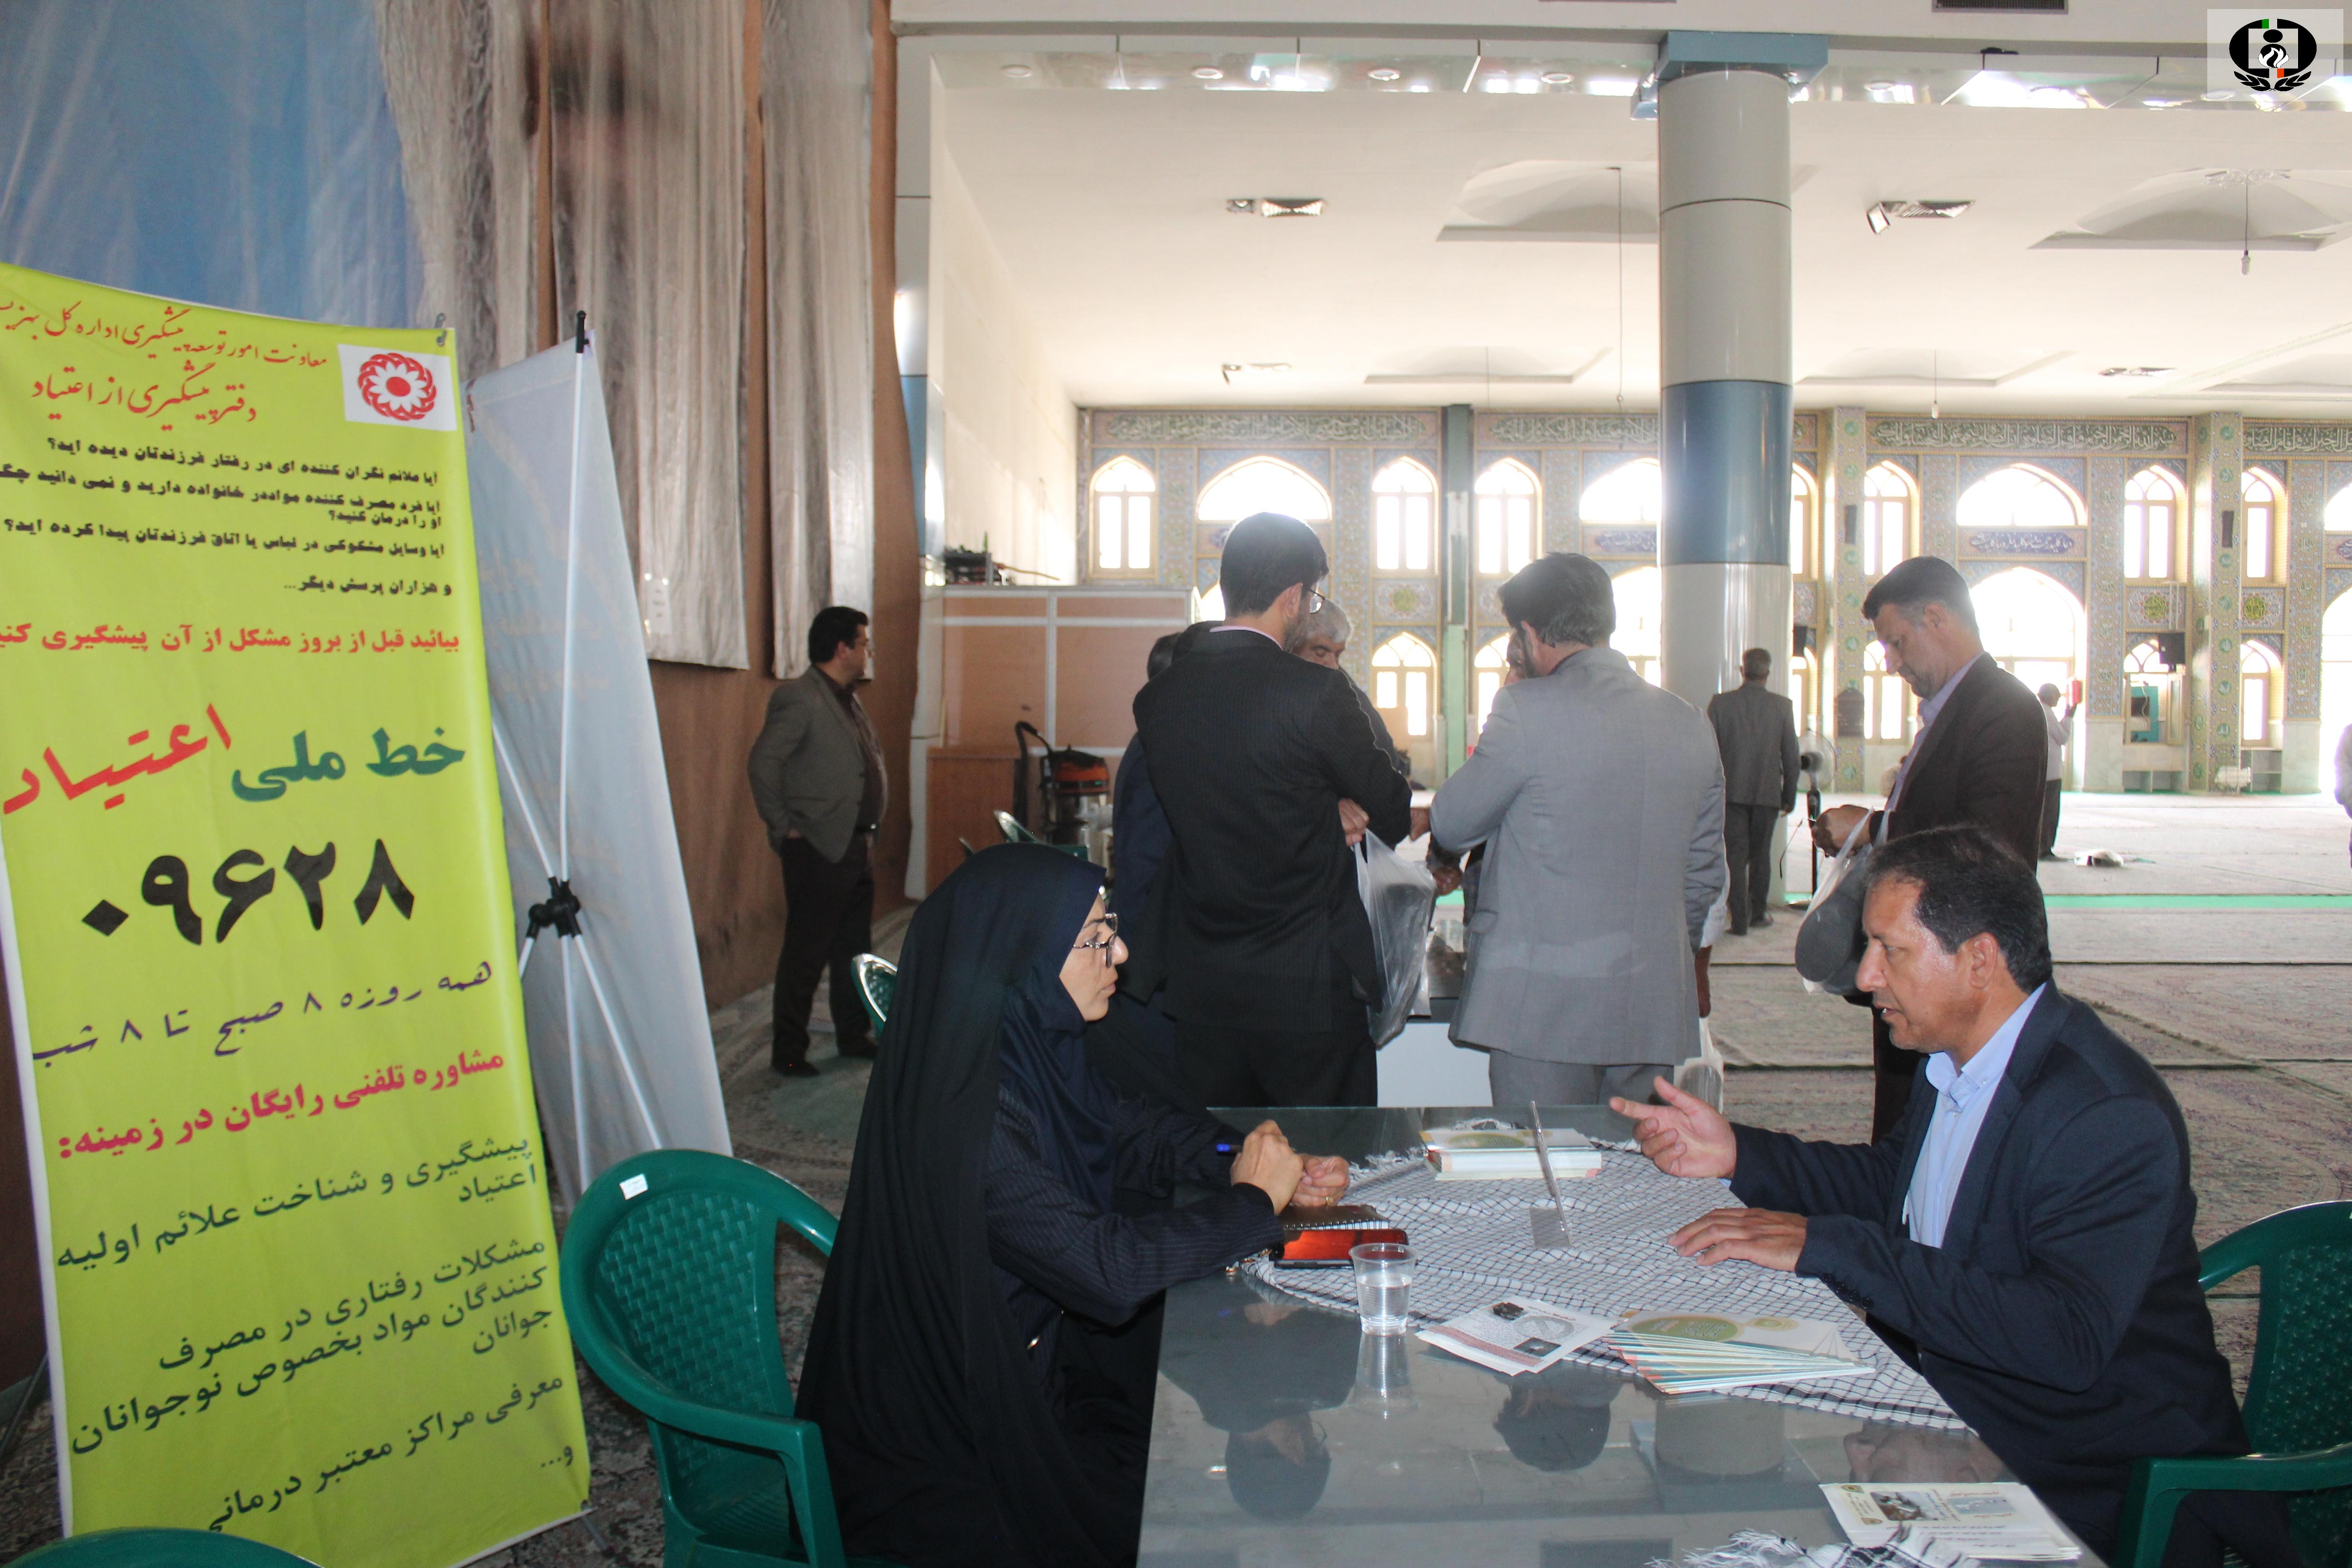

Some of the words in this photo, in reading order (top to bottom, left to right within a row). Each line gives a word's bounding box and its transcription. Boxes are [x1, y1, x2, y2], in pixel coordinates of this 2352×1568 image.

[0, 301, 40, 340] بهزی
[44, 300, 83, 337] کل
[76, 319, 118, 338] اداره
[228, 344, 258, 358] امور
[264, 344, 327, 368] معاونت
[32, 366, 93, 420] اعتیاد
[98, 376, 122, 405] از
[127, 359, 218, 431] پیشگیری
[208, 383, 256, 425] دفتر
[88, 444, 128, 459] دیده
[134, 446, 205, 466] فرزندتان
[211, 454, 250, 471] رفتار
[0, 463, 30, 484] چگ
[37, 470, 77, 485] دانید
[256, 461, 273, 472] در
[278, 460, 295, 474] ای
[301, 464, 340, 475] کننده
[82, 476, 115, 490] نمی
[122, 480, 131, 493] و
[137, 480, 181, 495] دارید
[187, 484, 245, 500] خانواده
[305, 494, 345, 505] کننده
[50, 522, 94, 538] کرده
[372, 512, 409, 527] درمان
[412, 514, 426, 529] را
[99, 524, 130, 543] پیدا
[135, 528, 206, 546] فرزندتان
[245, 534, 257, 549] یا
[263, 536, 297, 550] لباس
[303, 541, 319, 552] در
[324, 539, 384, 554] مشکوکی
[389, 543, 426, 558] وسایل
[340, 578, 384, 595] پرسش
[389, 580, 438, 596] هزاران
[444, 584, 452, 596] و
[0, 623, 32, 648] کنی
[42, 625, 148, 652] پیشگیری
[161, 624, 192, 651] آن
[203, 627, 222, 652] از
[229, 628, 291, 652] مشکل
[299, 633, 341, 653] بروز
[349, 630, 366, 653] از
[372, 629, 404, 653] قبل
[411, 630, 459, 652] بیائید
[3, 703, 231, 815] اعتیاد
[367, 727, 465, 776] خط
[232, 730, 346, 802] ملی
[81, 838, 415, 946] ۰۹۶۲۸
[438, 961, 492, 991] همه
[304, 992, 322, 1013] ۸
[121, 1019, 143, 1043] ۸
[164, 1009, 190, 1038] تا
[214, 1001, 284, 1057] صبح
[32, 1025, 98, 1068] شب
[413, 1050, 504, 1091] مشاوره
[333, 1065, 405, 1110] تلفنی
[225, 1083, 324, 1132] رایگان
[58, 1118, 164, 1159] زمینه:
[176, 1108, 213, 1145] در
[407, 1138, 532, 1187] پیشگیری
[254, 1171, 367, 1216] شناخت
[382, 1173, 394, 1194] و
[459, 1164, 536, 1202] اعتیاد
[155, 1205, 240, 1253] علائم
[57, 1223, 140, 1271] اولیه
[434, 1240, 544, 1283] مشکلات
[326, 1278, 422, 1326] رفتاری
[442, 1266, 547, 1327] کنندگان
[280, 1308, 312, 1342] در
[374, 1313, 430, 1342] مواد
[473, 1311, 552, 1354] جوانان
[159, 1327, 266, 1369] مصرف
[237, 1331, 362, 1397] بخصوص
[72, 1372, 222, 1455] نوجوانان
[486, 1378, 563, 1424] معرفی
[406, 1411, 475, 1457] مراکز
[315, 1443, 392, 1494] معتبر
